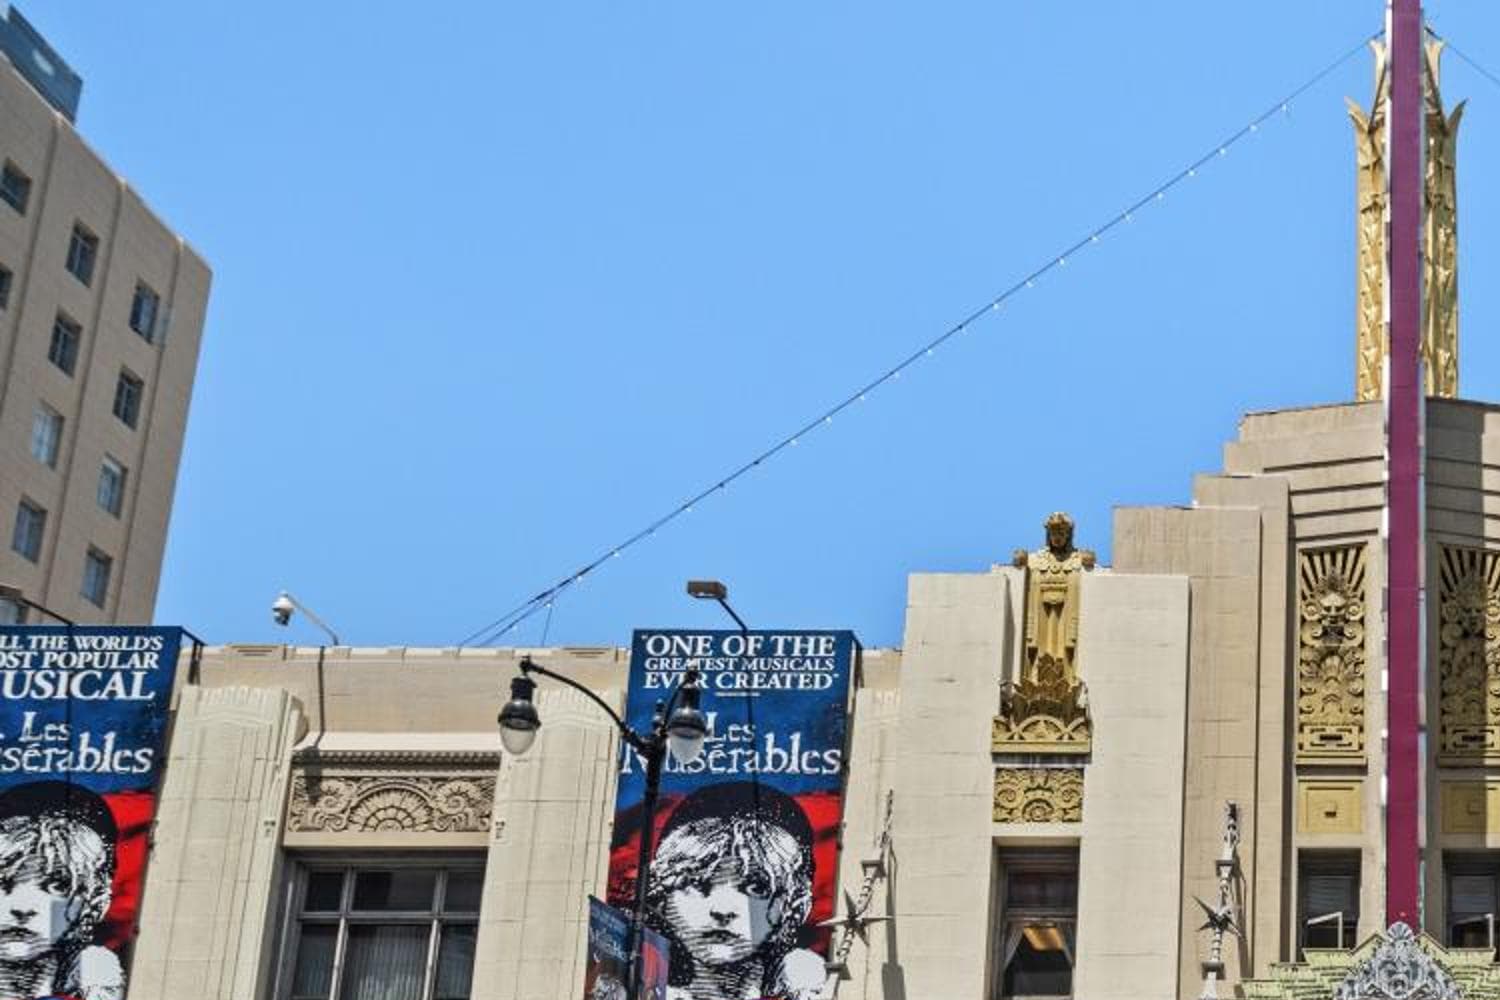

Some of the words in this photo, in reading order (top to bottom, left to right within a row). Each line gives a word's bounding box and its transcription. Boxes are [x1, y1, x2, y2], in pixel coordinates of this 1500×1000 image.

[28, 635, 69, 650] THE
[74, 635, 164, 650] WORLD'S
[722, 635, 764, 657] OF
[770, 635, 836, 657] THE
[41, 651, 161, 669] POPULAR
[644, 657, 738, 671] GREATEST
[741, 657, 835, 671] MUSICALS
[18, 711, 70, 742] Les
[703, 711, 757, 743] Les
[0, 731, 154, 773] sérables
